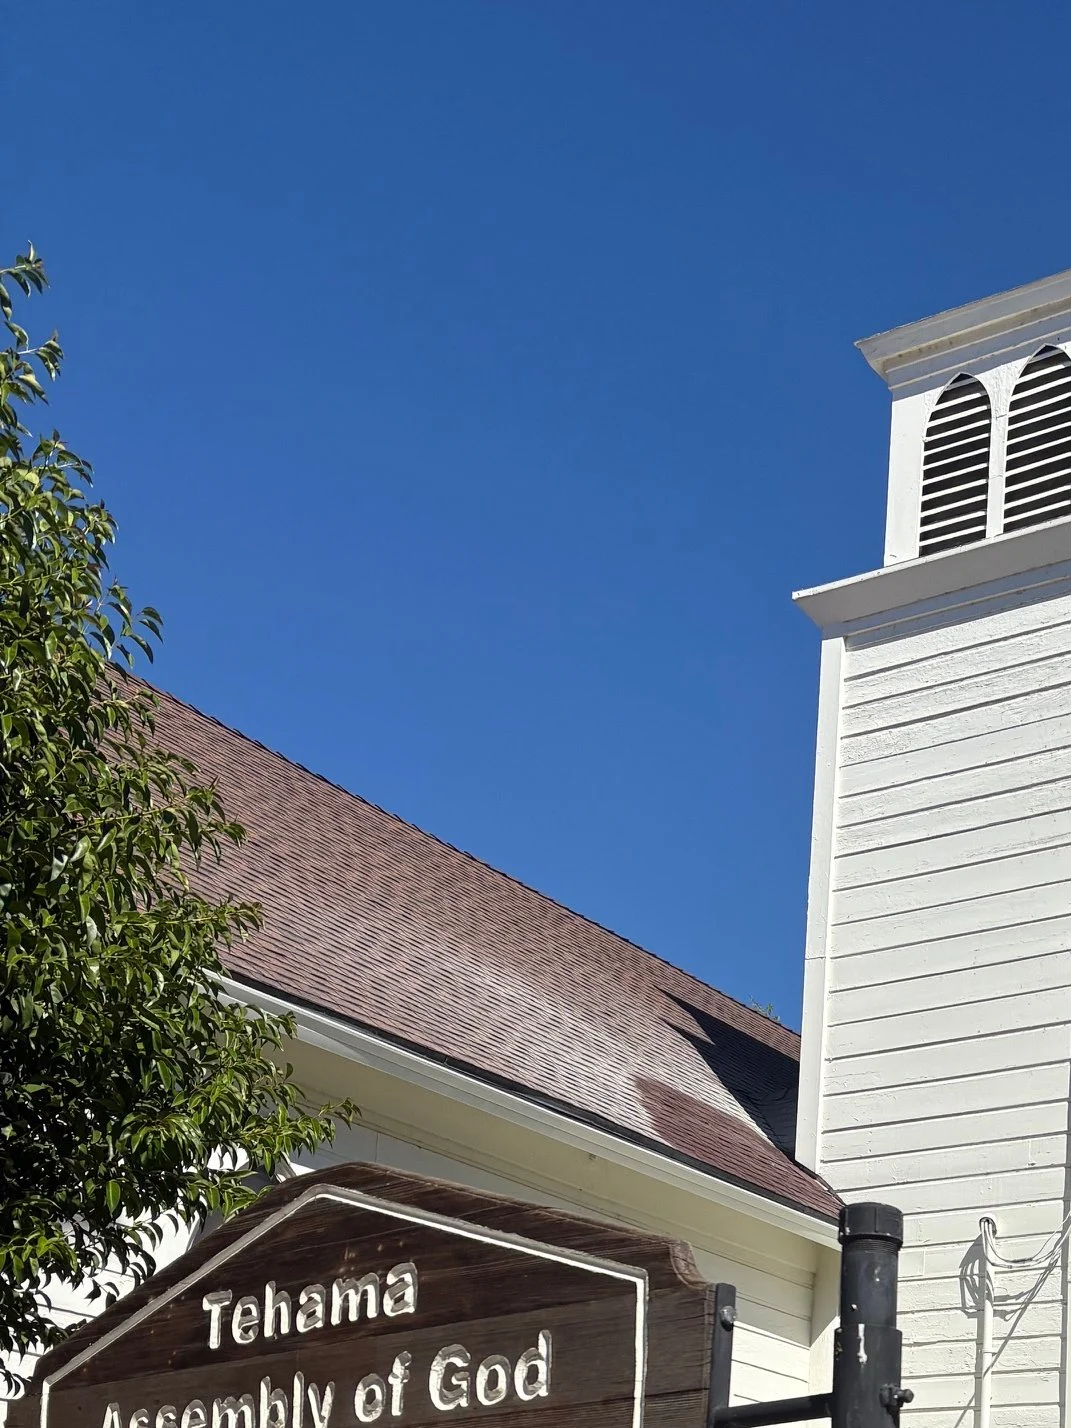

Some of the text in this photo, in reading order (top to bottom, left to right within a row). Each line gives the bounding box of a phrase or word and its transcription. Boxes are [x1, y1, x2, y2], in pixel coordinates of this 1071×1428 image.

[203, 1262, 418, 1349] Tehama
[354, 1350, 413, 1423] of
[428, 1329, 553, 1411] God
